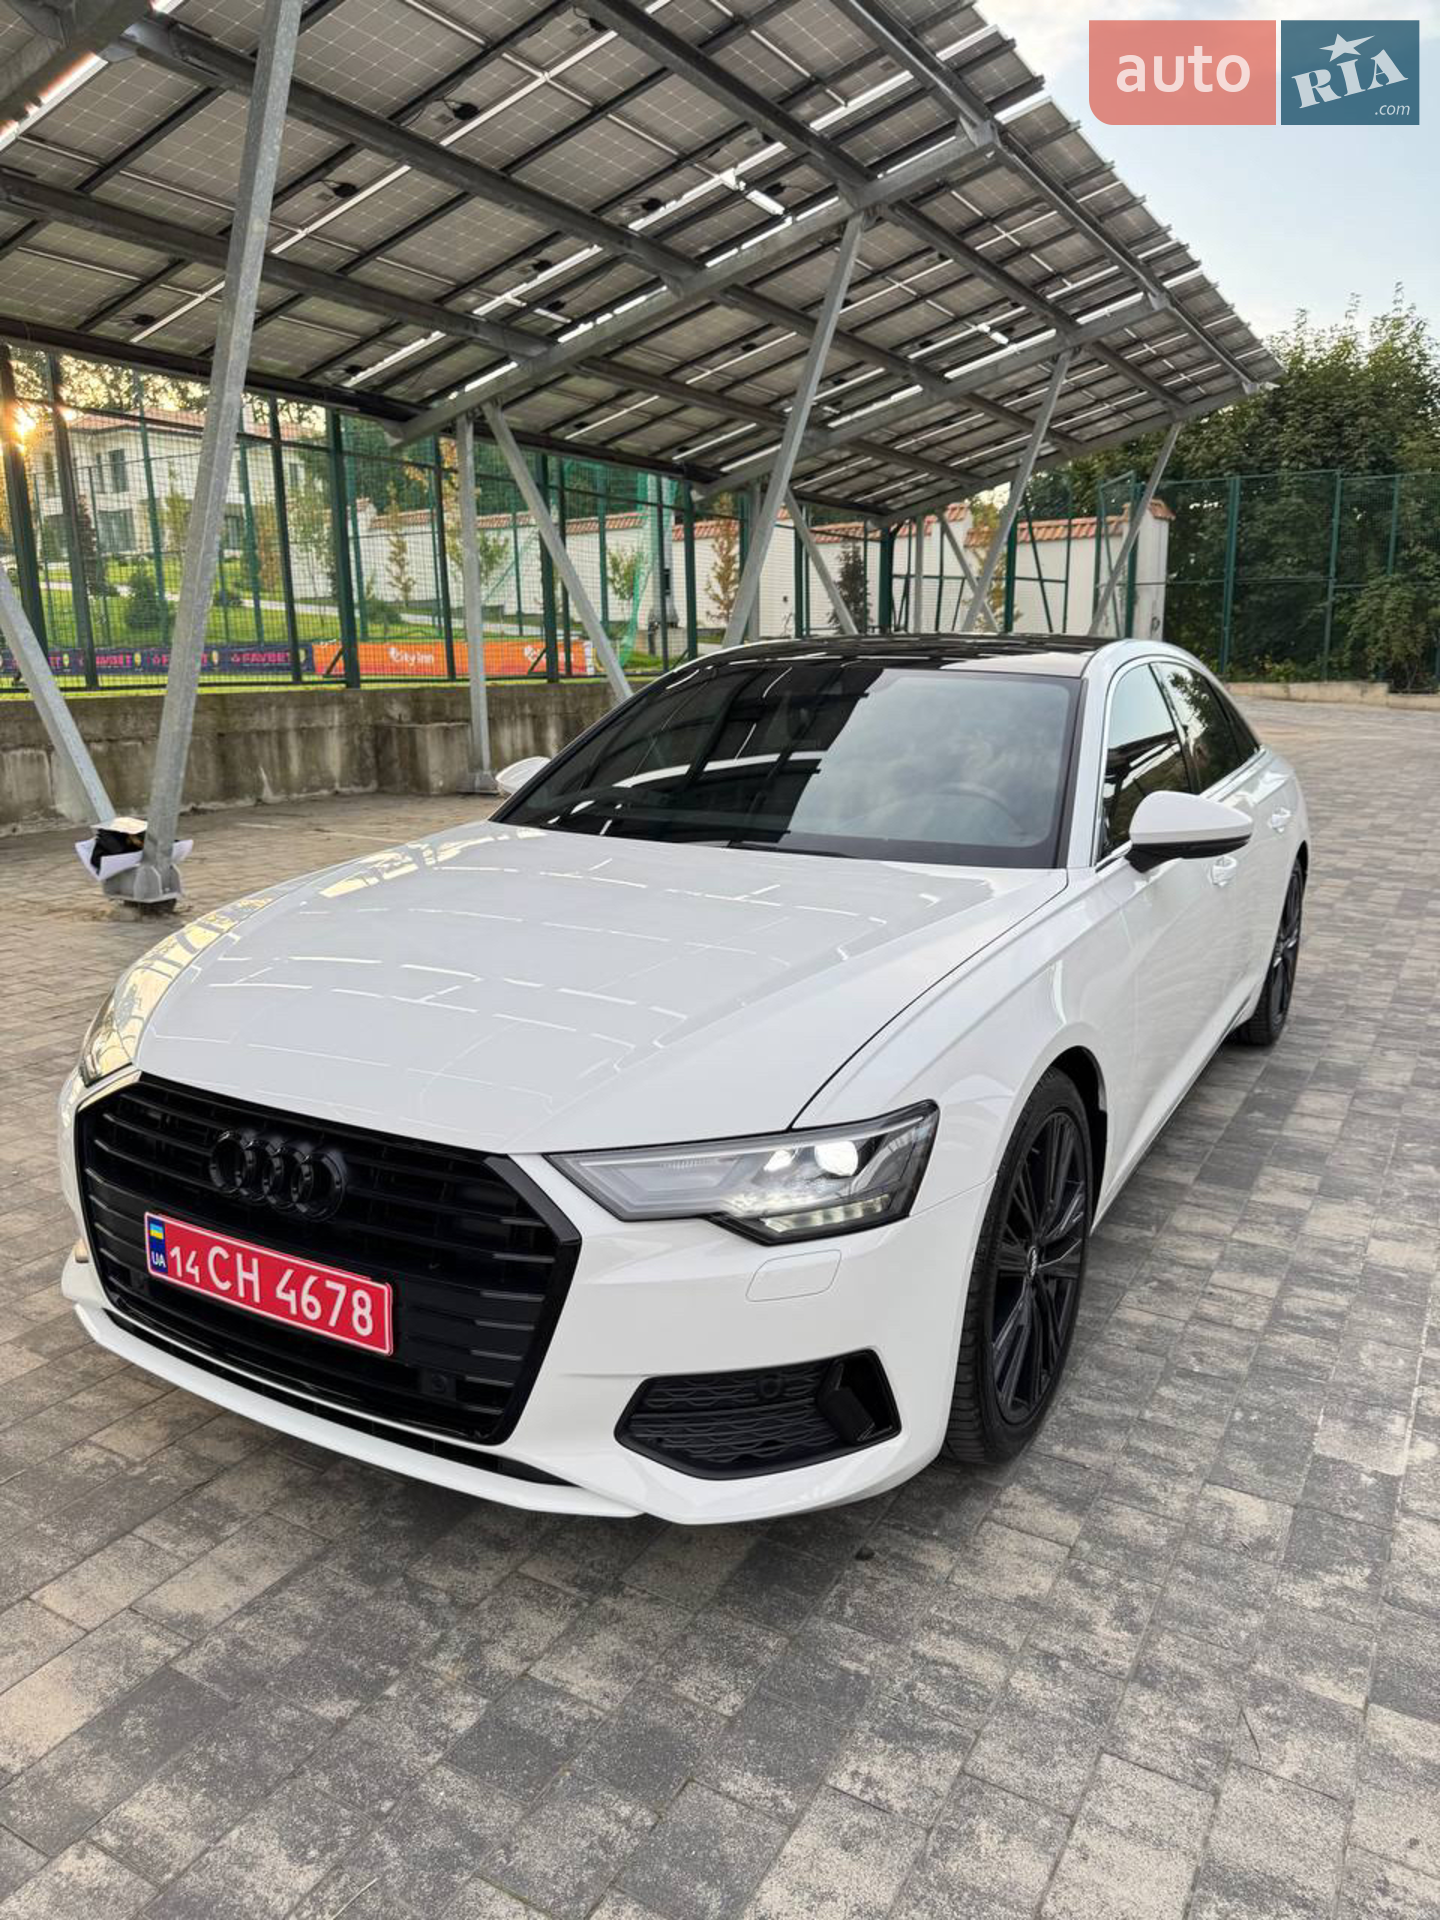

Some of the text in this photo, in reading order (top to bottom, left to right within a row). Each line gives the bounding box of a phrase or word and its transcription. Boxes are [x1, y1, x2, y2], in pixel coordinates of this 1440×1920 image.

[151, 1250, 167, 1268] UA
[170, 1246, 373, 1336] 14 CH 4678
